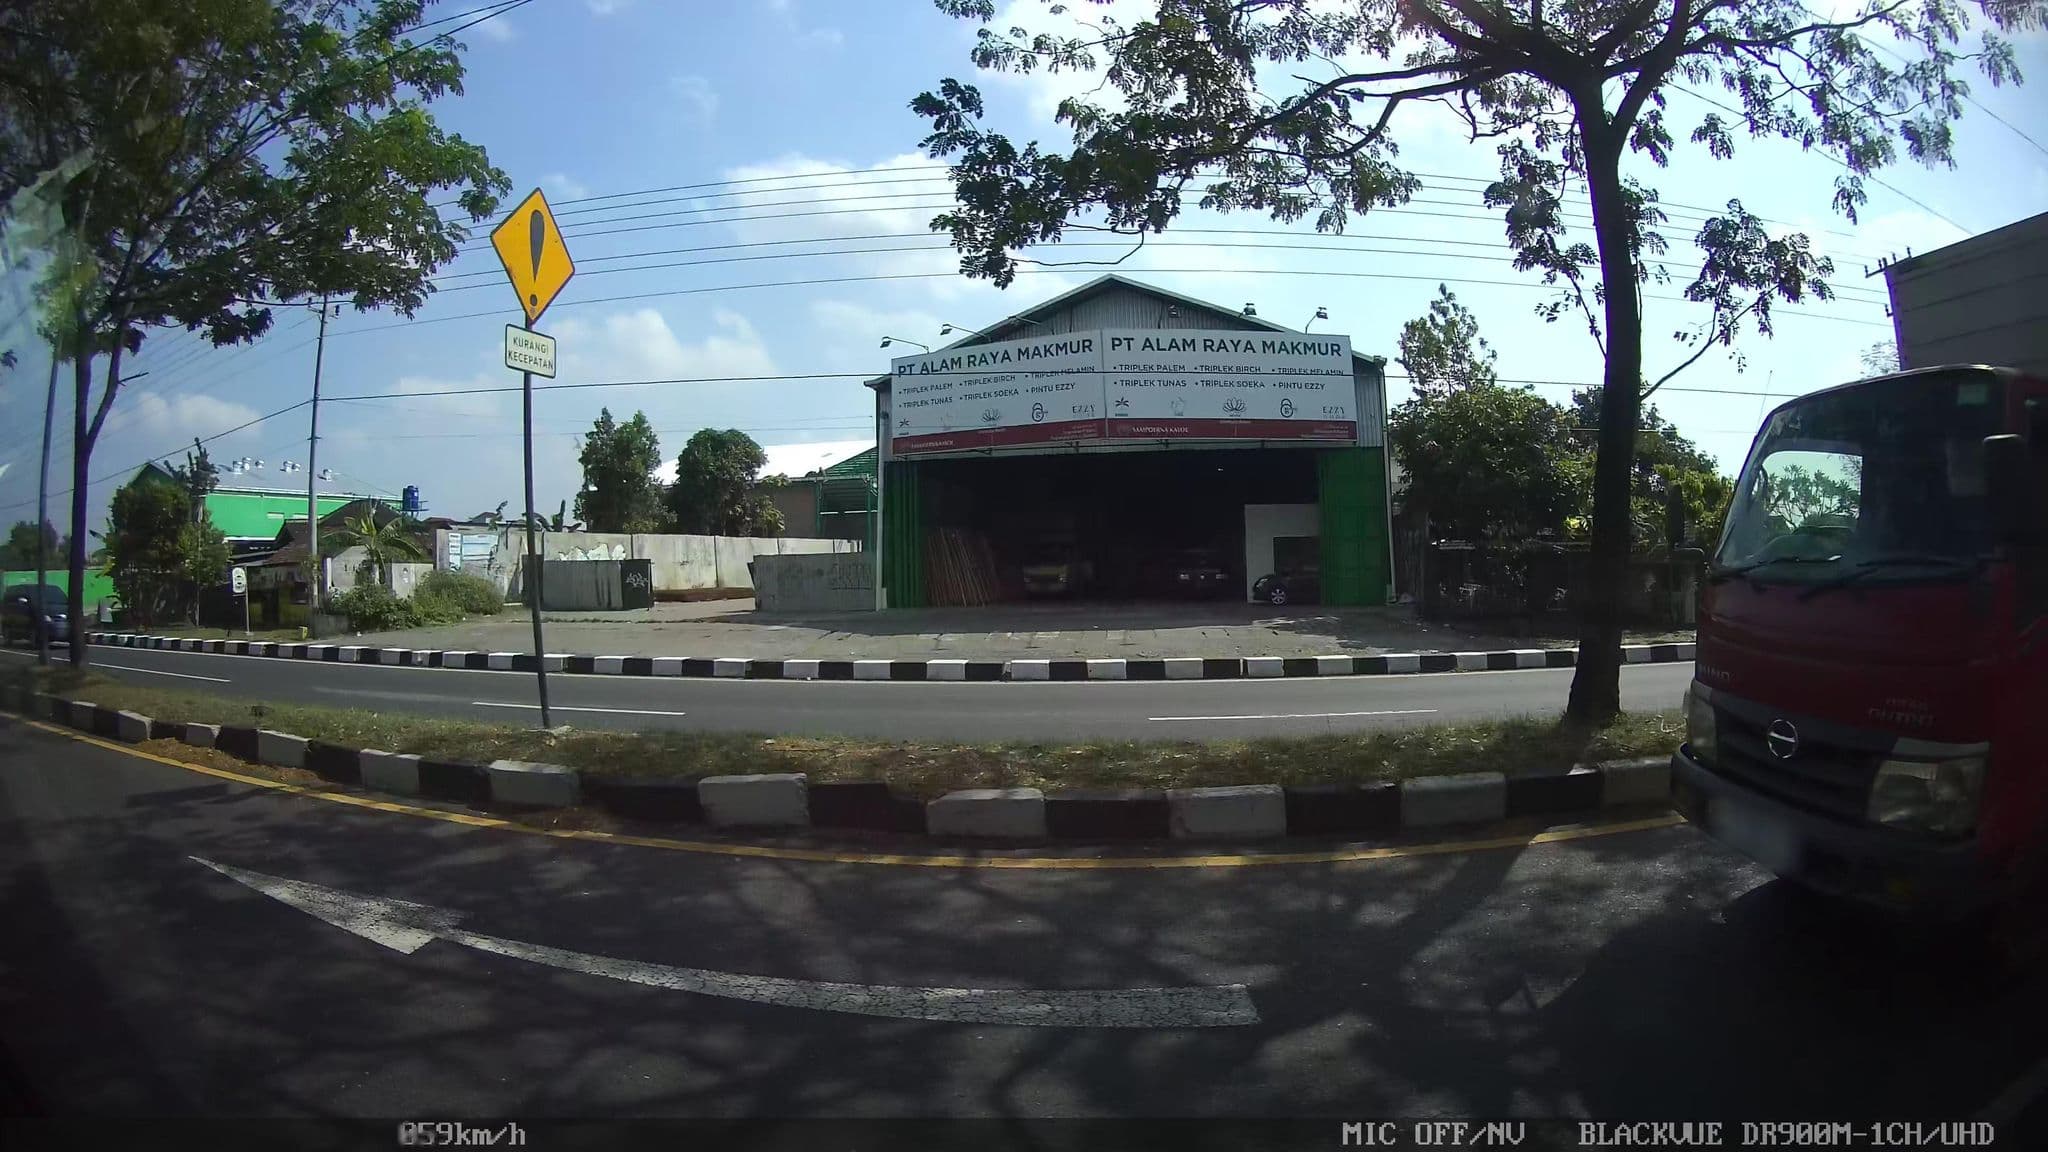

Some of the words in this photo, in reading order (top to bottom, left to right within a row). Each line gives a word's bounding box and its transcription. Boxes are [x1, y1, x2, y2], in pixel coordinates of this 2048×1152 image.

[513, 336, 549, 355] KURANGI
[1111, 337, 1135, 351] PT
[1141, 337, 1197, 352] ALAM
[1203, 338, 1257, 353] RAYA
[1261, 340, 1342, 357] MAKMUR
[508, 350, 554, 370] KECEPATAN
[898, 364, 916, 378] PT
[920, 357, 962, 375] ALAM
[967, 349, 1012, 368] RAYA
[1017, 339, 1093, 361] MAKMUR
[1119, 364, 1154, 373] TRIPLEK
[1157, 364, 1186, 373] PALEM
[1199, 365, 1234, 373] TRIPLEK
[1236, 365, 1261, 373] BIRCH
[964, 378, 993, 387] TRIPLEK
[994, 375, 1016, 383] BIRCH
[1200, 380, 1235, 388] TRIPLEK
[1237, 380, 1265, 388] SOEKA
[1278, 382, 1303, 390] PINTU
[1304, 383, 1326, 391] EZZY
[903, 386, 929, 395] TRIPLEK
[930, 383, 953, 392] PALEM
[1031, 385, 1054, 394] PINTU
[1055, 382, 1076, 392] EZZY
[964, 392, 993, 401] TRIPLEK
[994, 388, 1019, 398] SOEKA
[903, 400, 929, 409] TRIPLEK
[930, 397, 953, 405] TUNAS
